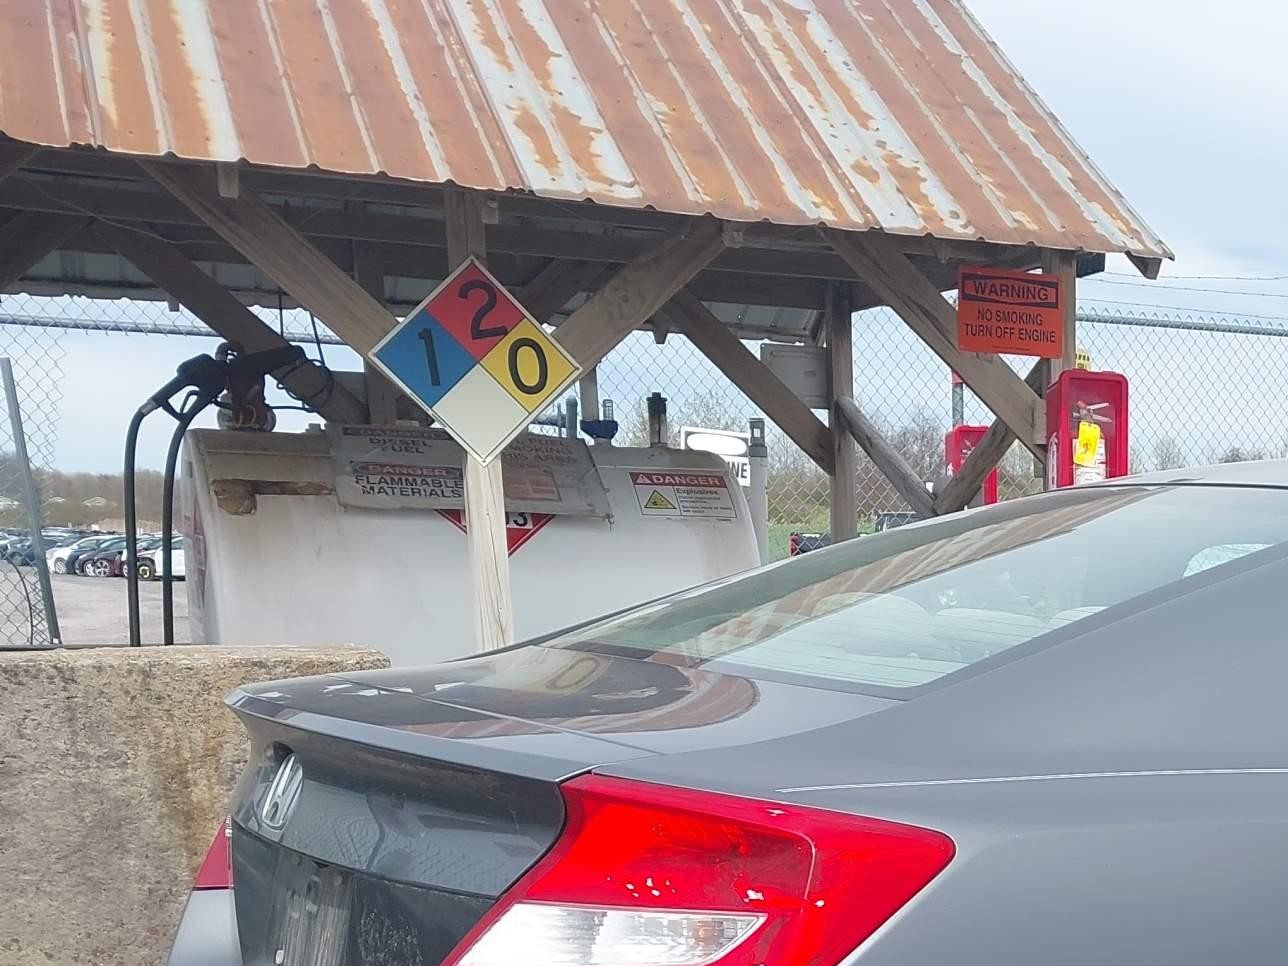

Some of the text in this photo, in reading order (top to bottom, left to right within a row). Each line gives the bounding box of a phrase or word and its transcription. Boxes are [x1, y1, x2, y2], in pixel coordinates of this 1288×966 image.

[973, 280, 1048, 300] WARNING
[458, 279, 508, 340] 2
[977, 308, 1043, 326] NO SMOKING
[965, 323, 1056, 344] TURN OFF ENGINE
[417, 327, 441, 386] 1
[508, 337, 549, 396] 0
[367, 463, 448, 477] DANGER
[355, 475, 464, 490] FLAMMABLE
[651, 474, 720, 486] DANGER
[361, 486, 462, 499] MATERIALS
